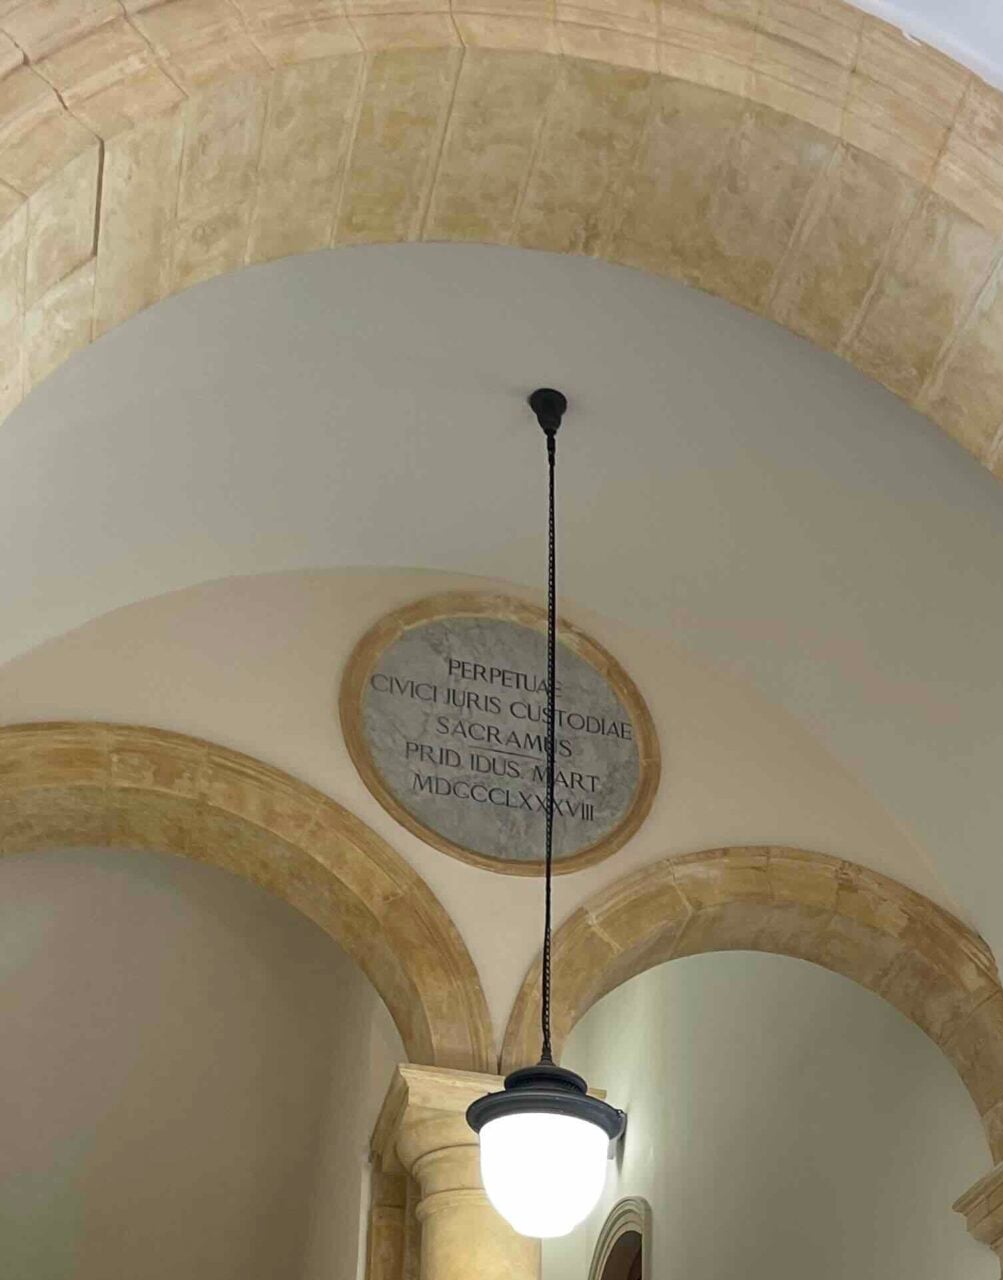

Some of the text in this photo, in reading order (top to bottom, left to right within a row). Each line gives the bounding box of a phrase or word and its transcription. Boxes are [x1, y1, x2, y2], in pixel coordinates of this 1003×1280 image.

[370, 673, 438, 703] CIVICI
[442, 687, 501, 715] JURIS
[405, 741, 462, 769] PRID
